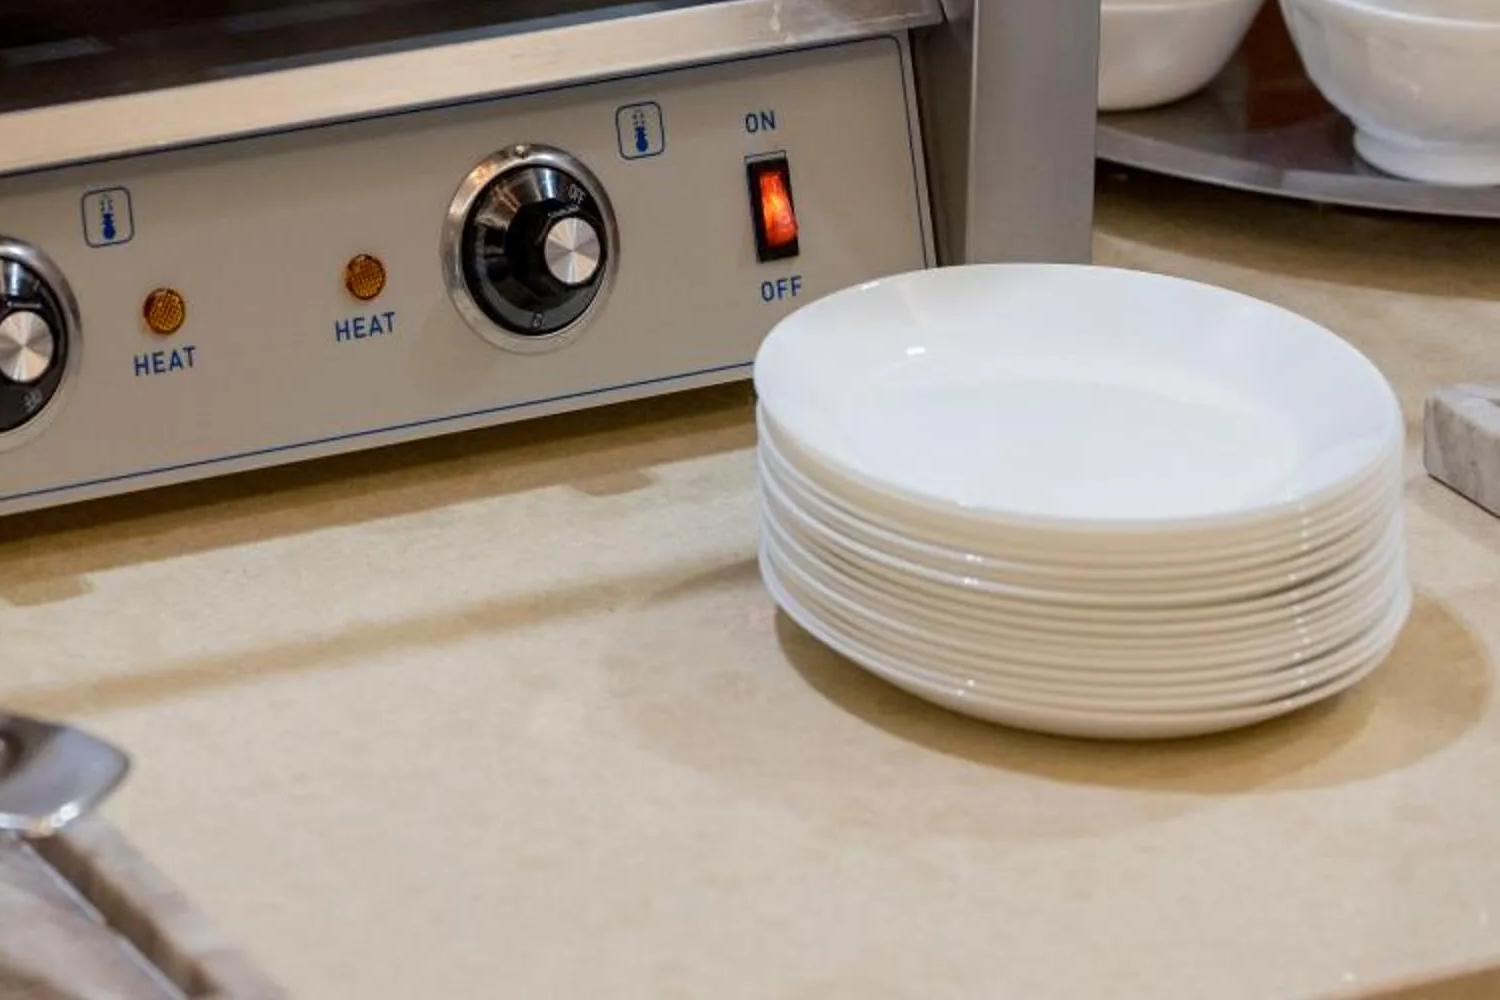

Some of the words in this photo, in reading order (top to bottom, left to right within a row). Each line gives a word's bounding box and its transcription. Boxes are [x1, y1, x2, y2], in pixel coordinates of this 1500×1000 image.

[745, 110, 776, 133] ON
[761, 276, 803, 302] OFF
[335, 311, 396, 342] HEAT
[133, 346, 196, 377] HEAT
